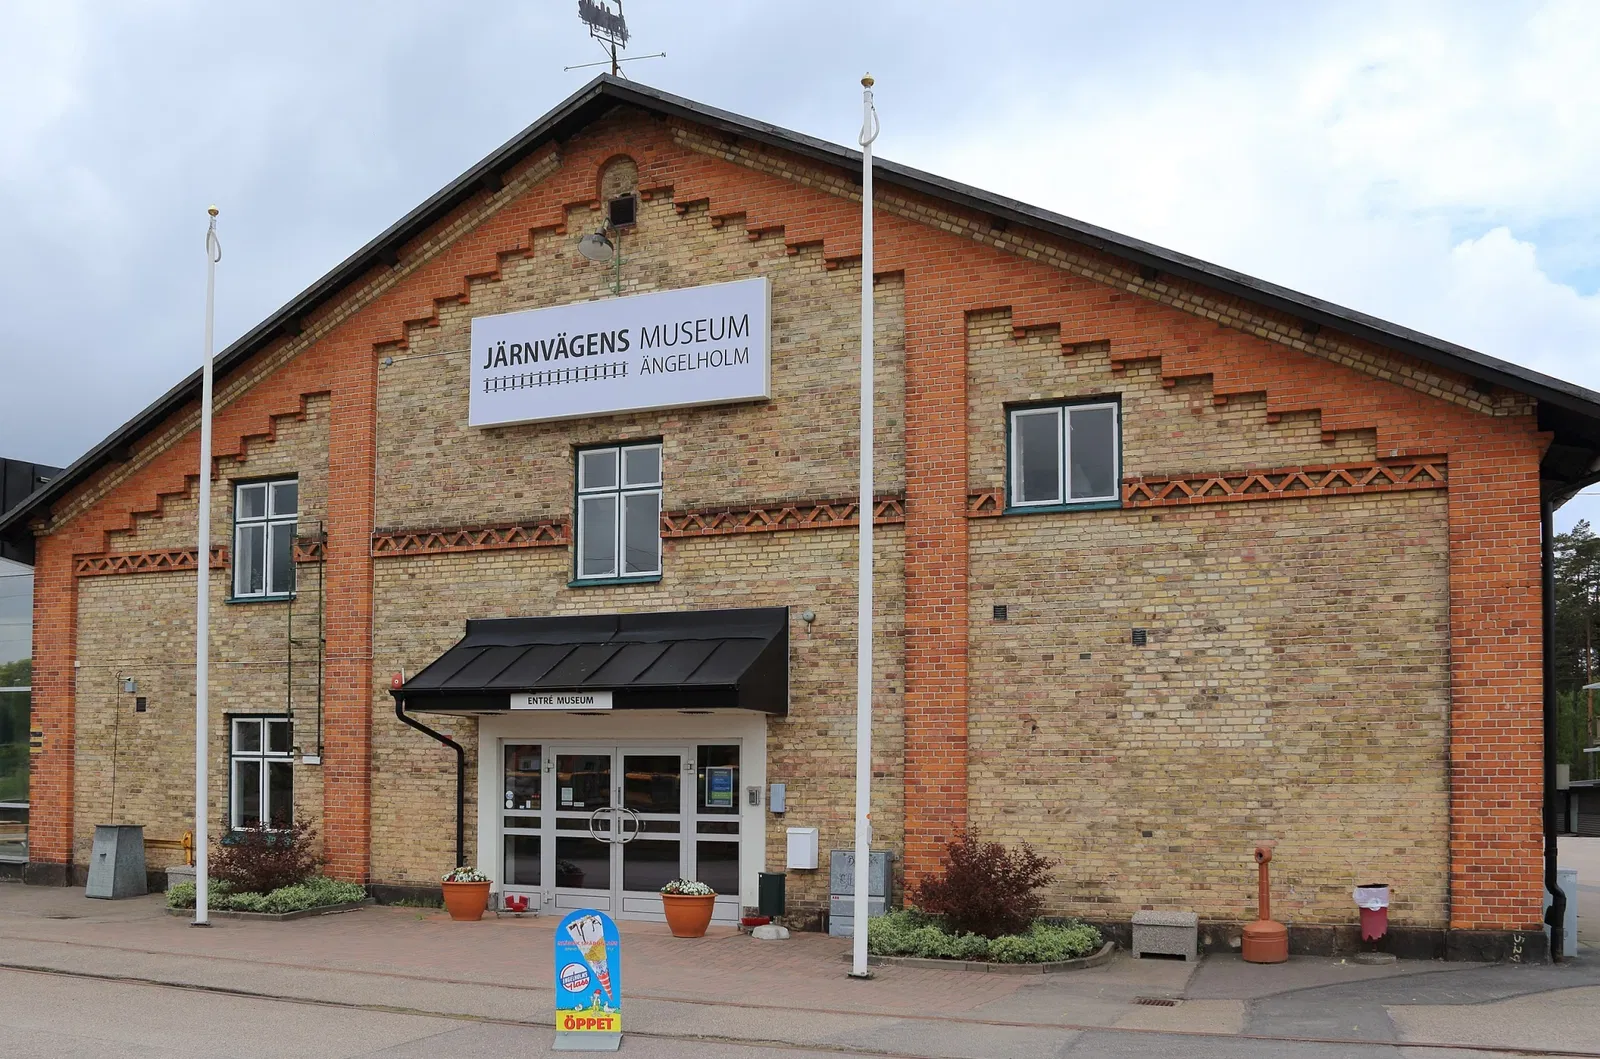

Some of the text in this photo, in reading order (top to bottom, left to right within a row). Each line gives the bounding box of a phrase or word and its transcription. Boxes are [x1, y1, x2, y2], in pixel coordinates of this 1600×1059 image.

[483, 314, 750, 370] JÄRNVÄGENS MUSEUM
[640, 347, 750, 376] ÄNGELHOLM
[527, 695, 594, 705] ENTRÉ MUSEUM
[564, 1014, 614, 1030] ÖPPET
